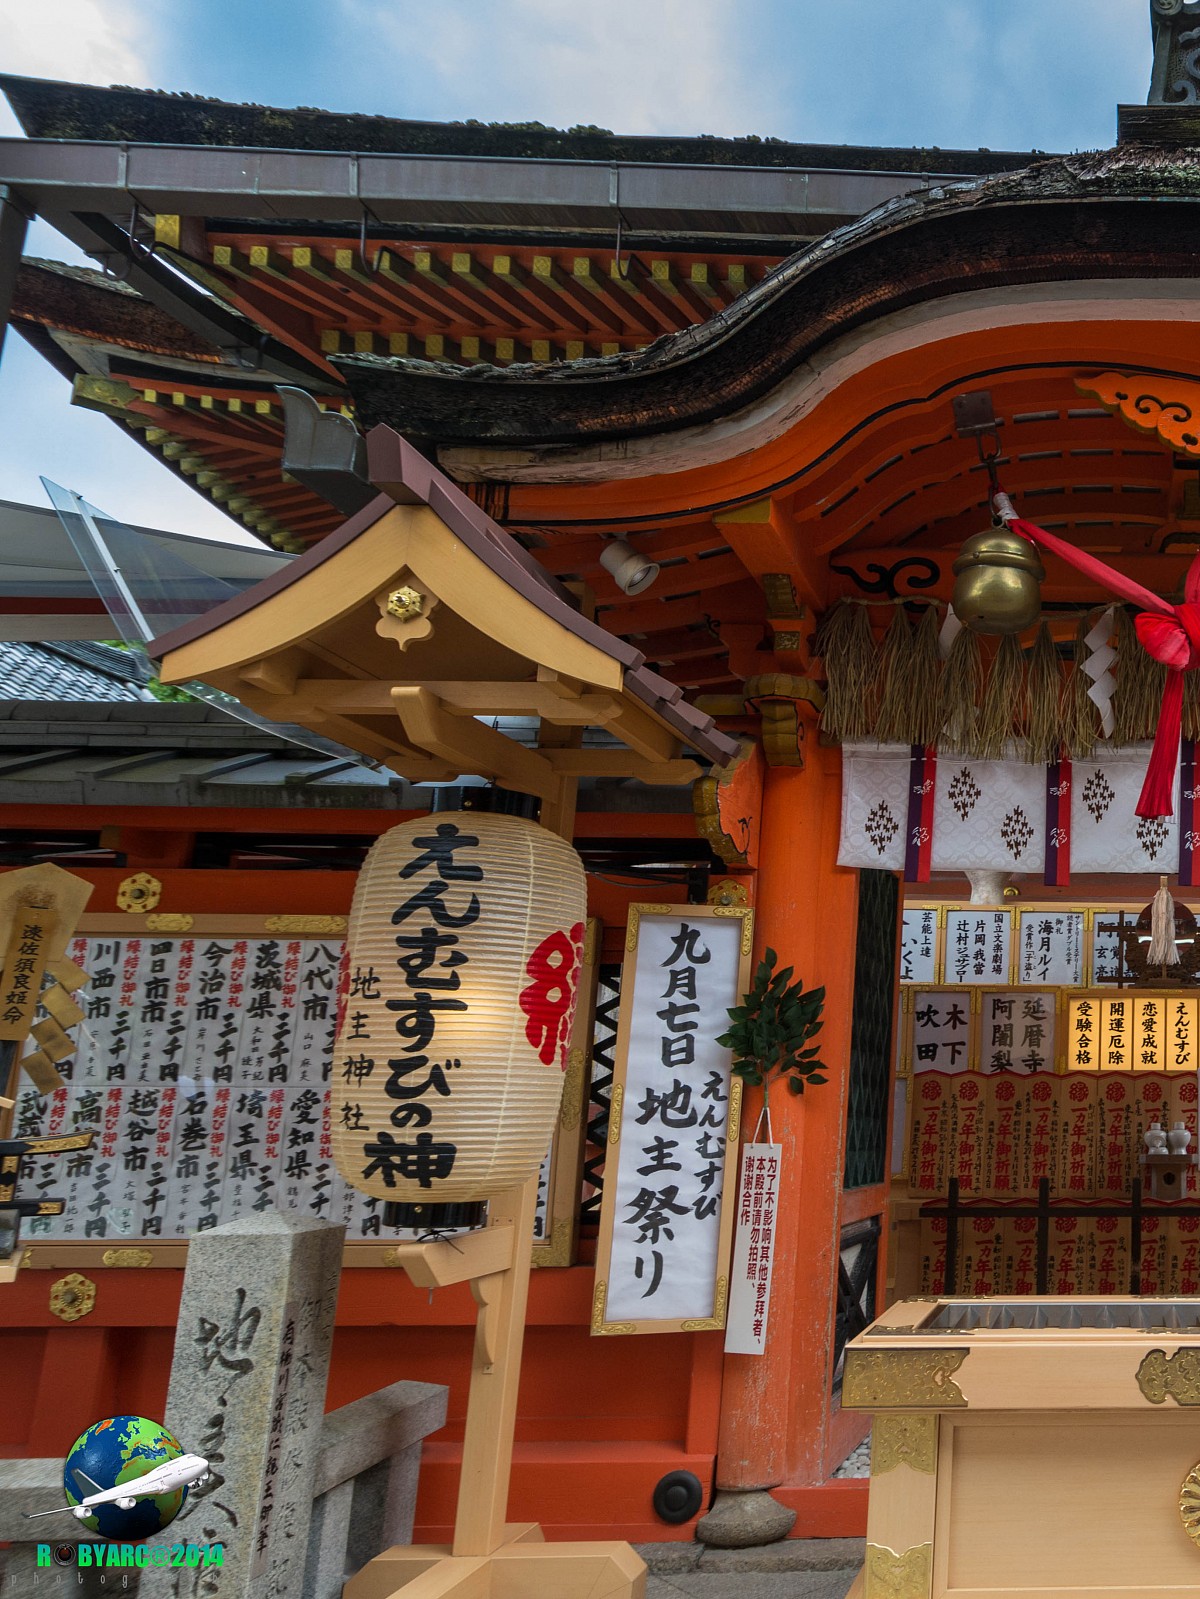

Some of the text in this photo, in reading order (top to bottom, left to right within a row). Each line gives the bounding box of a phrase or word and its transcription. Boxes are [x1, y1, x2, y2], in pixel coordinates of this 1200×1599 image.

[919, 911, 933, 958] 芸能上達
[972, 919, 986, 976] 片岡我當
[991, 913, 1004, 975] 国立文楽劇場
[1037, 919, 1054, 981] 海月ルイ
[1055, 918, 1064, 935] 御礼
[2, 924, 43, 1025] 速佐須良姫命
[86, 940, 121, 1020] 川西市
[119, 939, 142, 1007] 縁結び御礼
[141, 941, 174, 1024] 四日市市
[174, 939, 196, 1007] 縁結び御礼
[195, 941, 232, 1021] 今治市
[228, 940, 248, 1008] 縁結び御礼
[246, 940, 284, 1020] 茨城県
[281, 941, 301, 1009] 縁結び御礼
[301, 942, 341, 1021] 八代市
[360, 823, 484, 1189] えんむすびの神
[106, 1010, 132, 1082] 三千円
[159, 1010, 186, 1082] 三千円
[213, 1012, 239, 1084] 三千円
[268, 1012, 292, 1083] 三千円
[338, 967, 382, 1132] 地主神社
[915, 1004, 941, 1062] 吹田
[942, 1004, 968, 1065] 木下
[1021, 998, 1047, 1073] 延暦寺
[1075, 1001, 1093, 1065] 受験合格
[1108, 1001, 1126, 1065] 開運厄除
[1141, 1001, 1158, 1065] 恋愛成就
[1174, 1001, 1191, 1065] えんむすび
[66, 1090, 103, 1178] 高市
[100, 1087, 123, 1158] 縁結び御礼
[122, 1089, 160, 1172] 越谷市
[155, 1087, 177, 1158] 縁結び御礼
[176, 1091, 209, 1179] 石巻市
[209, 1088, 231, 1158] 縁結び御礼
[229, 1089, 267, 1181] 埼玉県
[264, 1089, 285, 1159] 縁結び御礼
[284, 1088, 321, 1180] 愛知県
[622, 922, 711, 1299] 九月七日 地主祭り
[692, 1071, 729, 1222] えんむすび
[29, 1163, 58, 1235] 三円
[85, 1162, 111, 1238] 三千円
[141, 1161, 167, 1237] 三千円
[198, 1161, 222, 1232] 三千円
[740, 1156, 755, 1226] 谢谢合作
